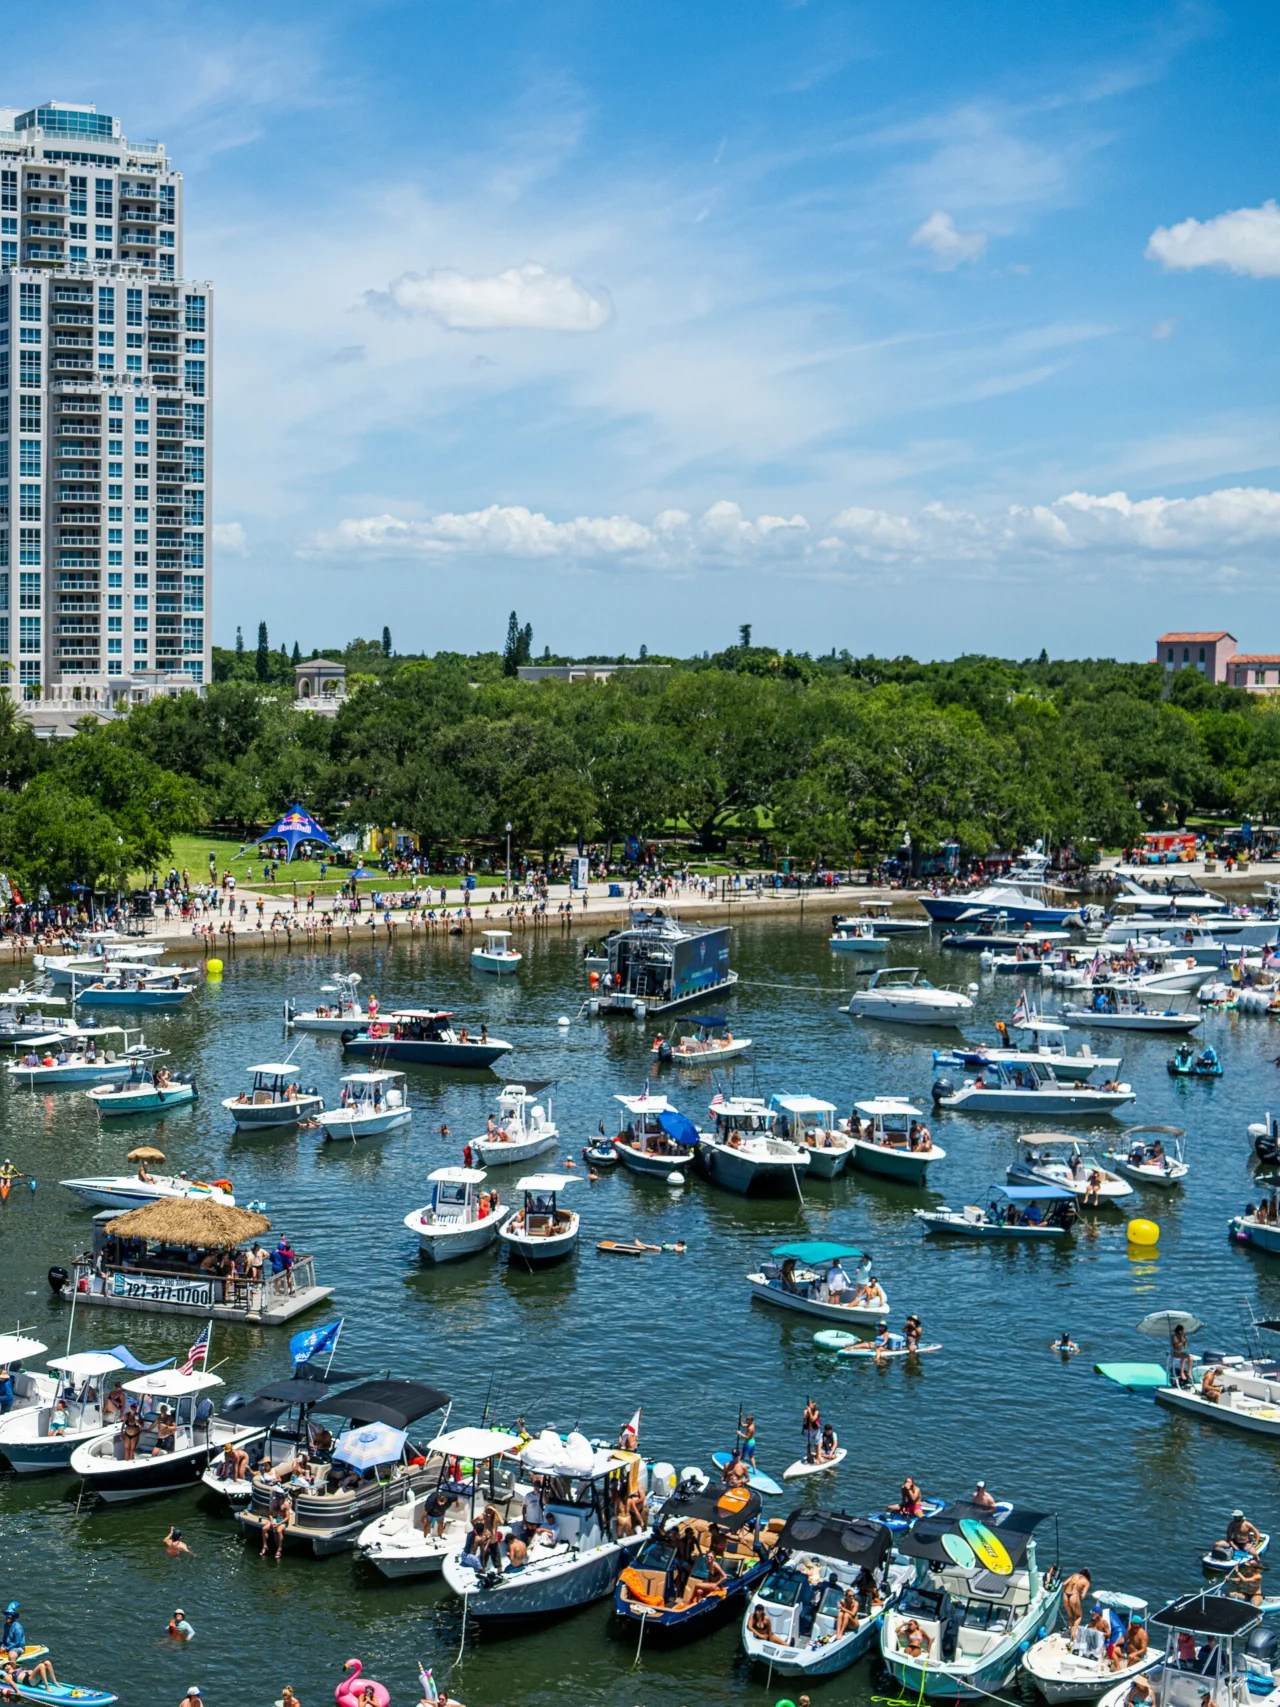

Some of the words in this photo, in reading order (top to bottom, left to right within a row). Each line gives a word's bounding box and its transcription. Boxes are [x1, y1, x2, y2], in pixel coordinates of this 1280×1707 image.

[277, 823, 295, 832] Red
[295, 823, 312, 834] Bull
[126, 1282, 208, 1305] 727-377-0700
